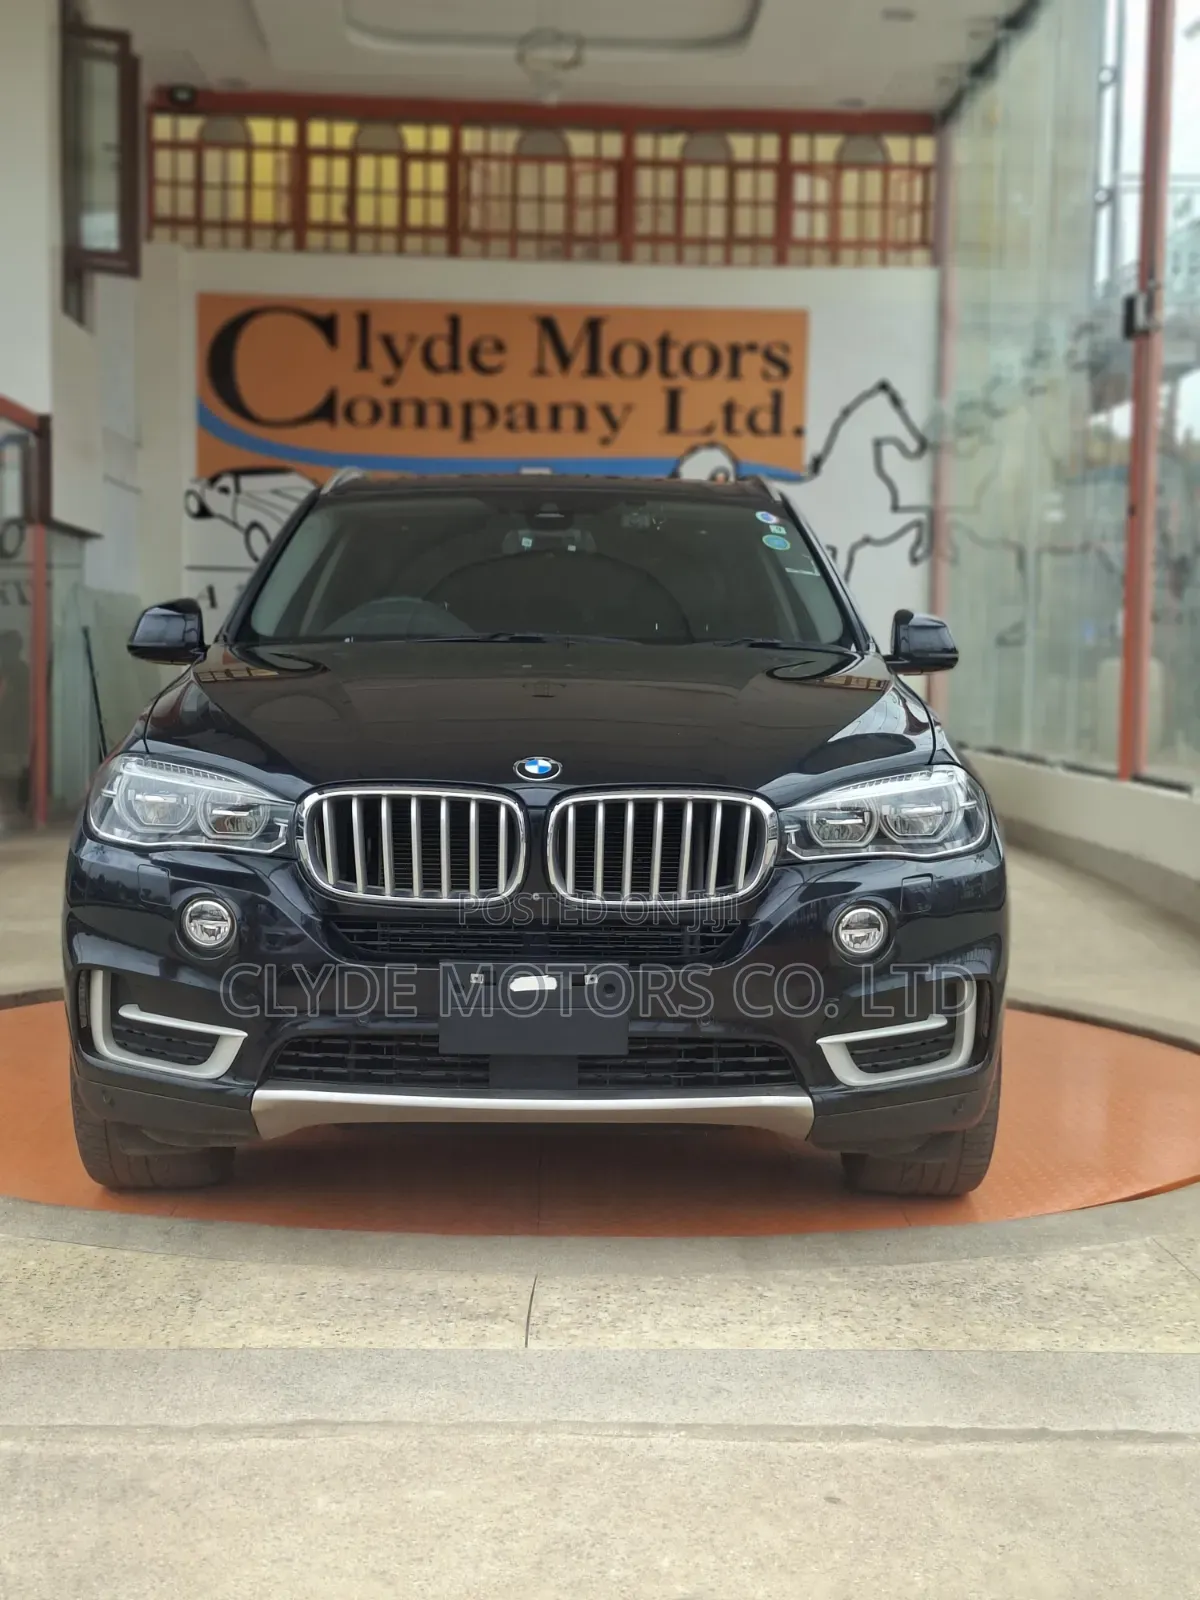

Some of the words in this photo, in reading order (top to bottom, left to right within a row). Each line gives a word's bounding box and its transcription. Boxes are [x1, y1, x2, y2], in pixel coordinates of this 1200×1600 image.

[206, 305, 507, 429] Clyde
[532, 314, 792, 382] Motors
[658, 386, 805, 438] Ltd.
